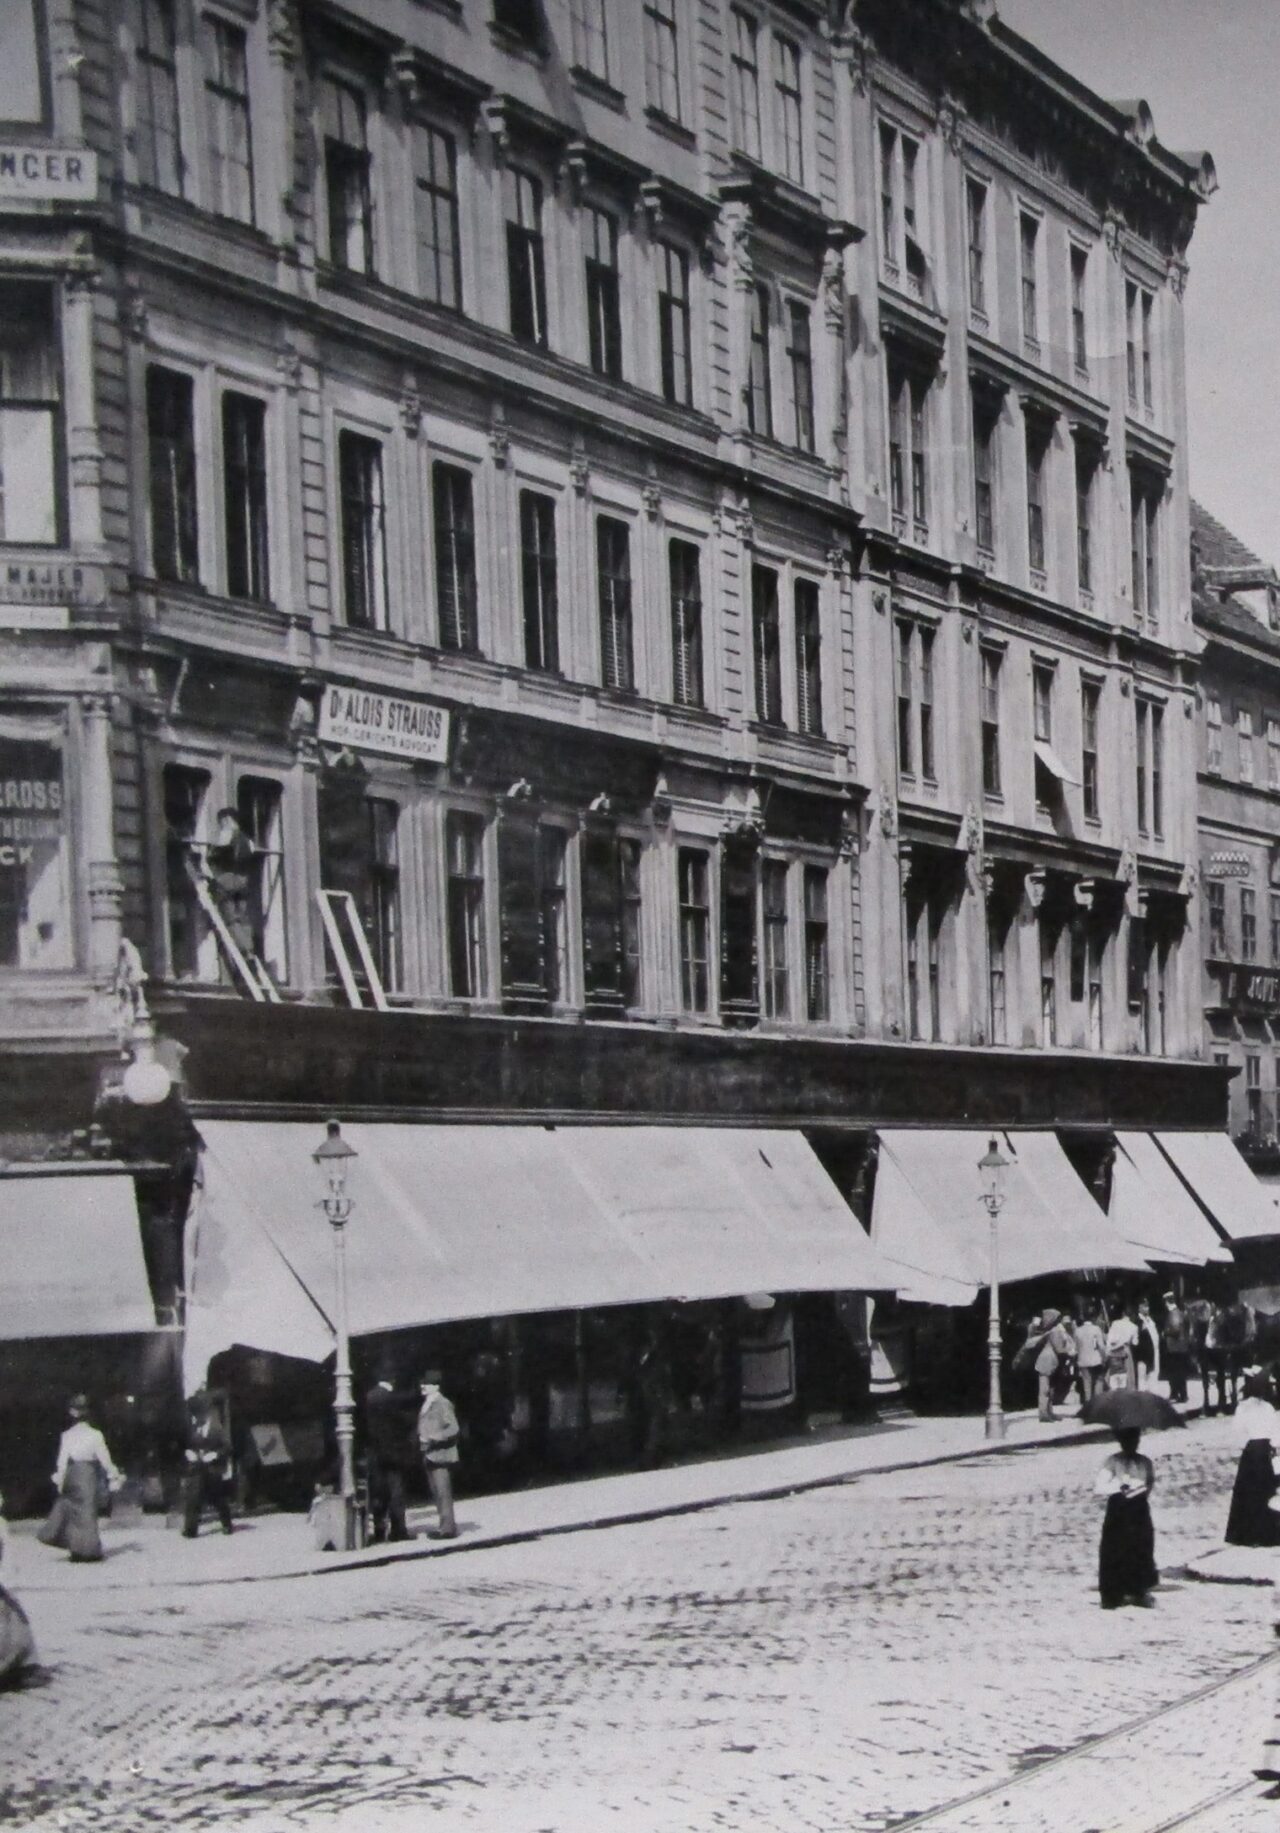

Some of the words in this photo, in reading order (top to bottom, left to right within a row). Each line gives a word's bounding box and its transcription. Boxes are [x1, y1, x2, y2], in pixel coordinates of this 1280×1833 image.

[346, 694, 383, 728] ALOIS
[388, 702, 442, 739] STRAUSS
[0, 781, 61, 809] ROSS
